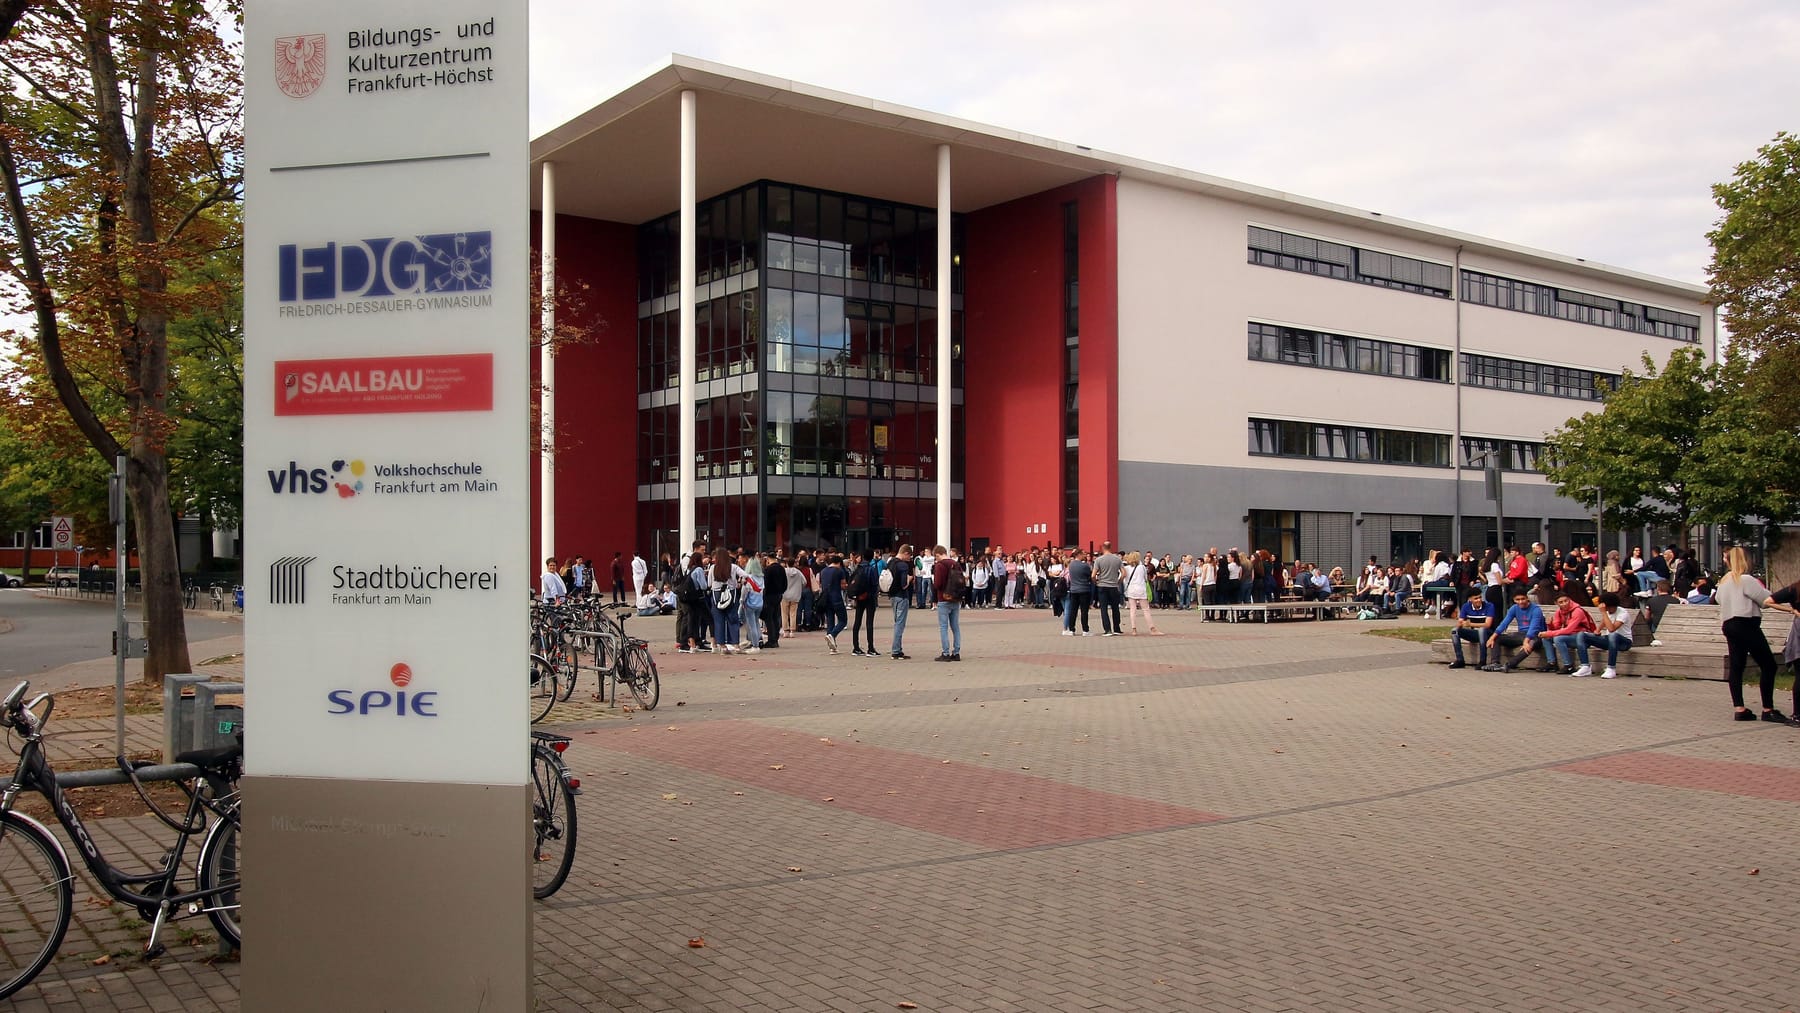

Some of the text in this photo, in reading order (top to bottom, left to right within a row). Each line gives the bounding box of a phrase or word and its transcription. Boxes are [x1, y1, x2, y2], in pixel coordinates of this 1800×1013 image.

[348, 17, 494, 49] Bildungs- und
[348, 46, 492, 73] Kulturzentrum
[348, 67, 494, 93] Frankfurt-Höchst
[279, 294, 492, 318] FRIEDRICH-DESSAUER-GYMNASIUM
[301, 368, 423, 394] SAALBAU
[374, 462, 482, 477] Volkshochschule
[919, 455, 932, 463] vhs
[268, 461, 328, 494] vhs
[374, 479, 498, 494] Frankfurt am Main
[332, 564, 498, 590] Stadtbücherei
[332, 593, 432, 605] Frankfurt am Main
[327, 689, 438, 717] SPIE
